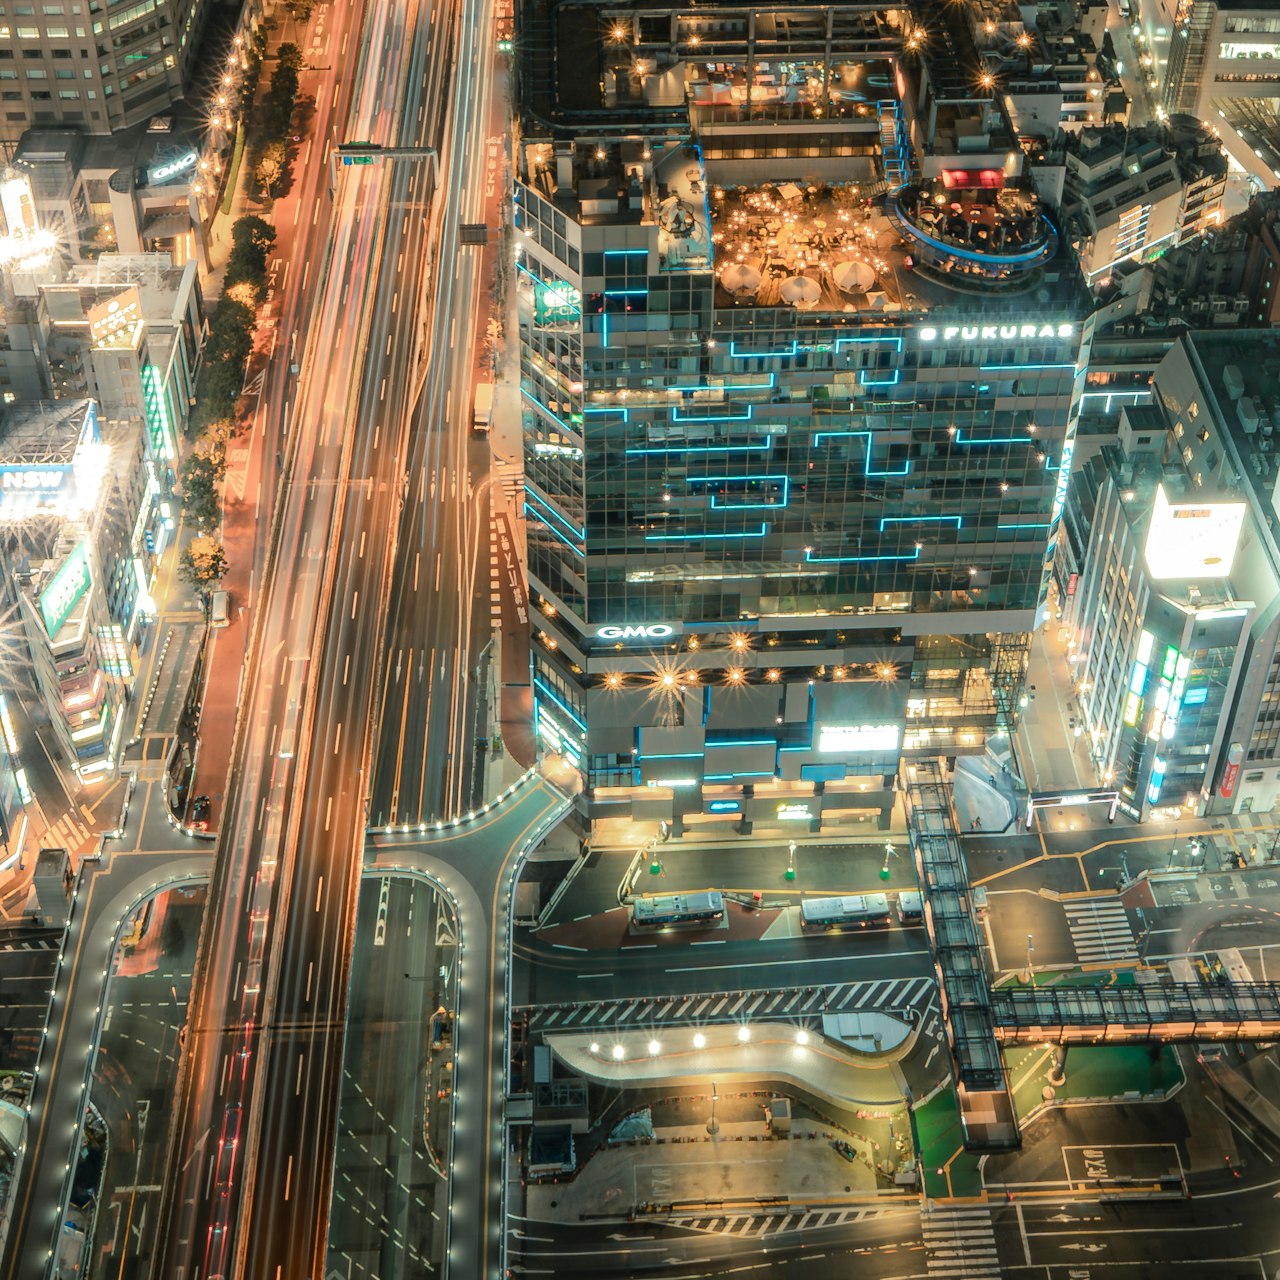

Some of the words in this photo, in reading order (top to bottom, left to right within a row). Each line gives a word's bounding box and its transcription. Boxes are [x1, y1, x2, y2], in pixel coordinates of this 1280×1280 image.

[312, 3, 329, 47] バス専用
[153, 153, 197, 179] GMO
[943, 323, 1073, 340] FUKURAS
[3, 471, 64, 488] NSW
[597, 623, 673, 640] GMO
